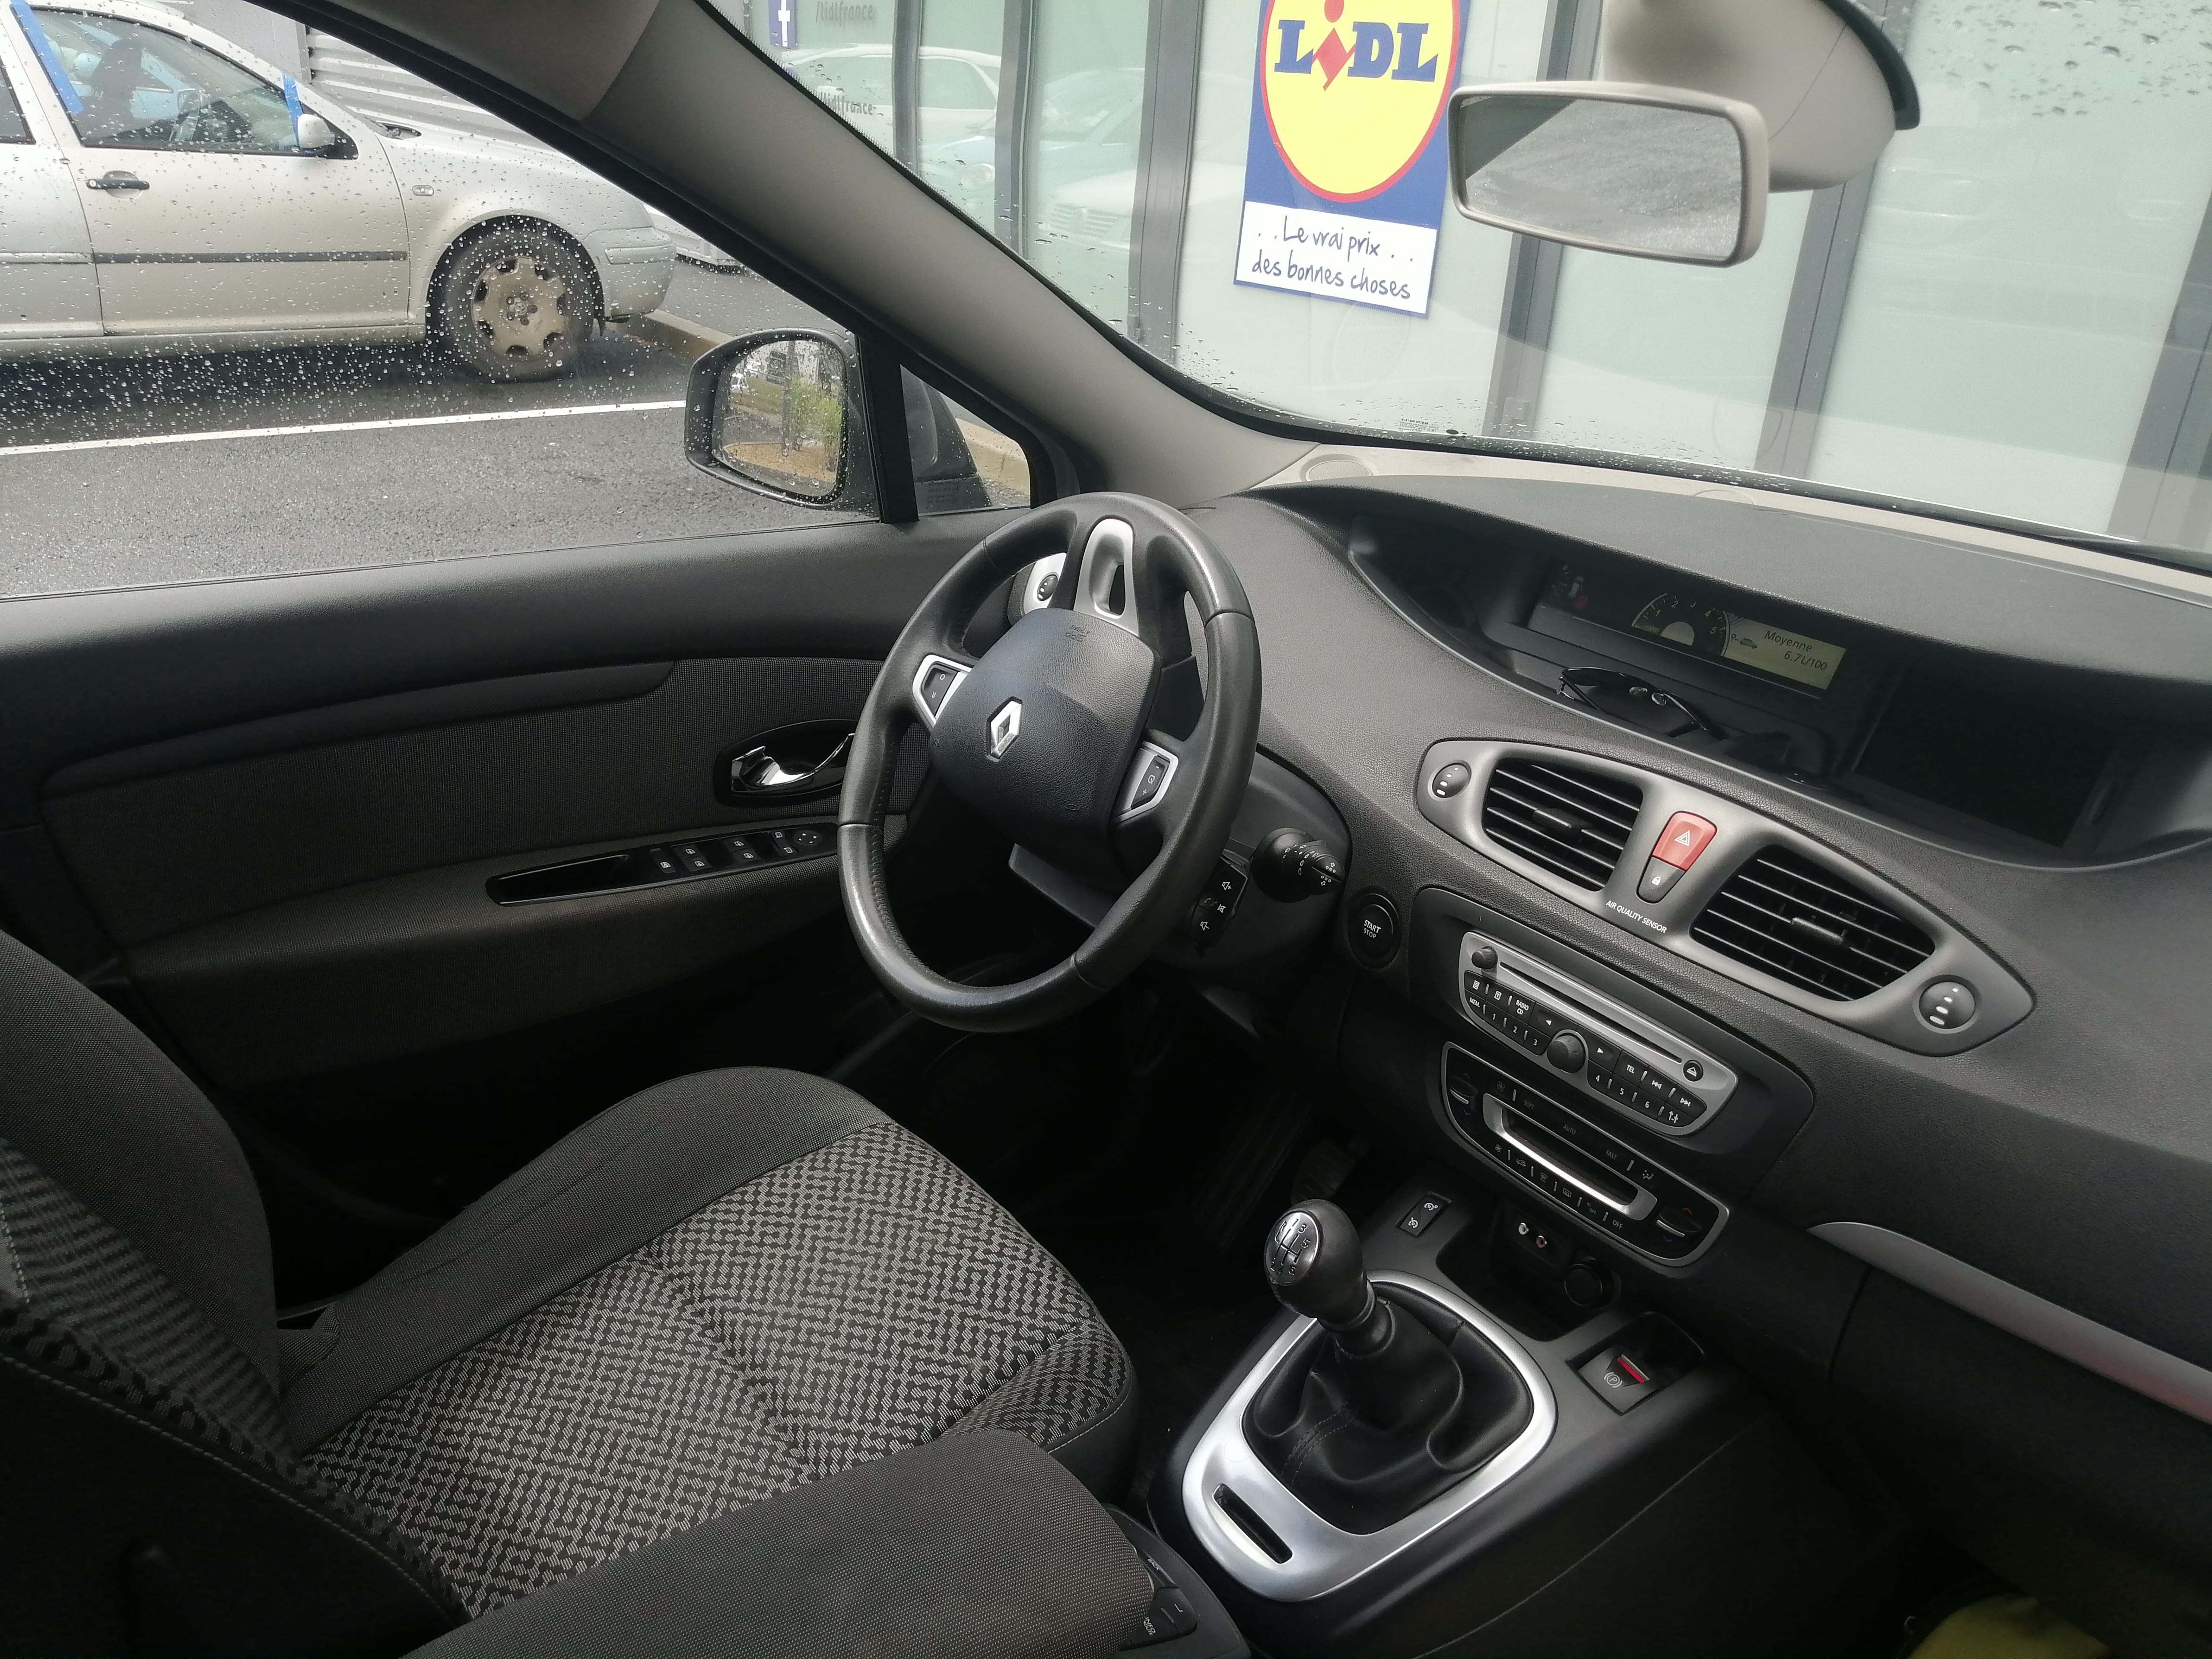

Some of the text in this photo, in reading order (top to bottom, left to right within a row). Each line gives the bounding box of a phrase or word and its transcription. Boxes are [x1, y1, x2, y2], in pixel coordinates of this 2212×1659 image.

[1284, 215, 1380, 262] Le vrai prix
[1252, 249, 1410, 299] des bonnes choses
[1671, 600, 1678, 608] 2
[1764, 631, 1812, 652] Moyenne
[1784, 651, 1827, 670] 6.7L/100
[1605, 900, 1667, 933] AIR QUALITY SENSOR
[1364, 919, 1381, 933] START
[1363, 928, 1376, 939] STOP
[1469, 997, 1480, 1007] MEM.
[1516, 1000, 1529, 1011] RADIO
[1626, 1064, 1635, 1074] TEL
[1524, 1100, 1535, 1109] SOFT
[1563, 1124, 1576, 1135] AUTO
[1605, 1150, 1618, 1160] FAST
[1297, 1224, 1308, 1233] 3
[1612, 1220, 1623, 1229] OFF
[1300, 1237, 1311, 1248] 5
[1147, 1558, 1159, 1571] BACK
[1145, 1617, 1156, 1634] INFO
